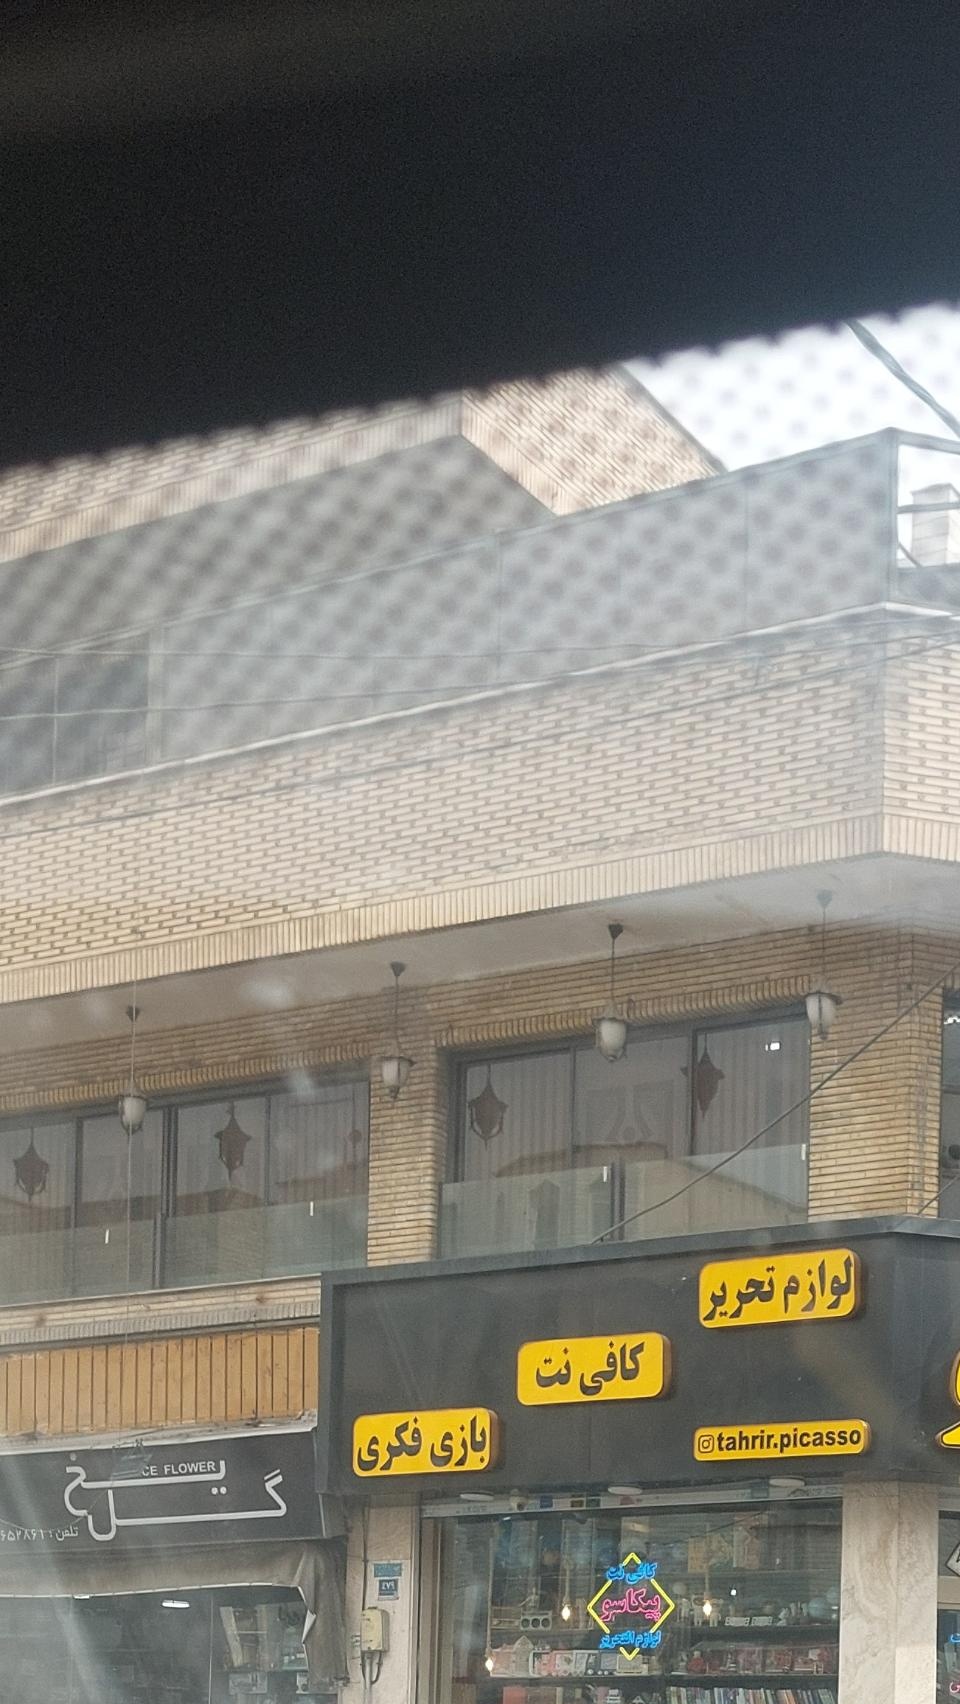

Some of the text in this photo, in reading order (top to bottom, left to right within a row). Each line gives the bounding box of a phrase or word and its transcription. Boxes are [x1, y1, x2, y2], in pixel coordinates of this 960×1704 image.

[703, 1255, 853, 1321] لوازم تحریر
[536, 1341, 645, 1396] کافی نت
[357, 1415, 487, 1471] بازی فکری
[717, 1428, 861, 1453] tahrir.picasso
[164, 1461, 216, 1475] FLOWER
[606, 1563, 657, 1584] کافی نت
[600, 1588, 662, 1622] پیکاسو
